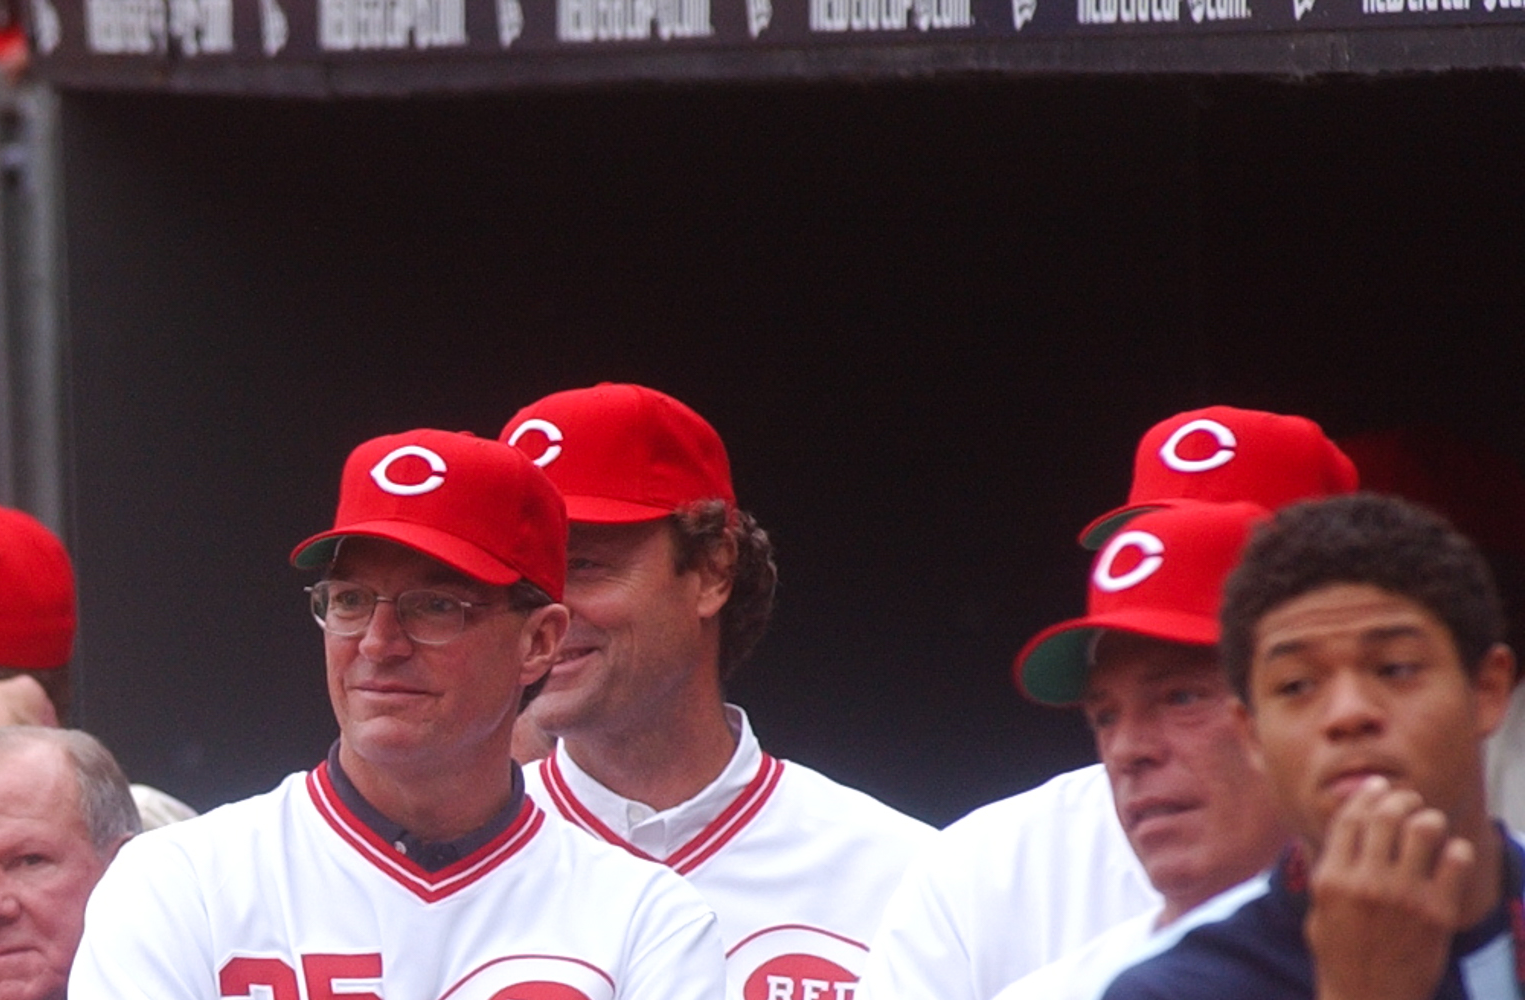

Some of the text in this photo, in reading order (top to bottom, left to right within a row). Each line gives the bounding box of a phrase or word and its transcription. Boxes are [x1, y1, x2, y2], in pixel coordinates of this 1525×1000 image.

[370, 445, 447, 495] C
[1159, 419, 1237, 472] C
[1093, 530, 1165, 591] C
